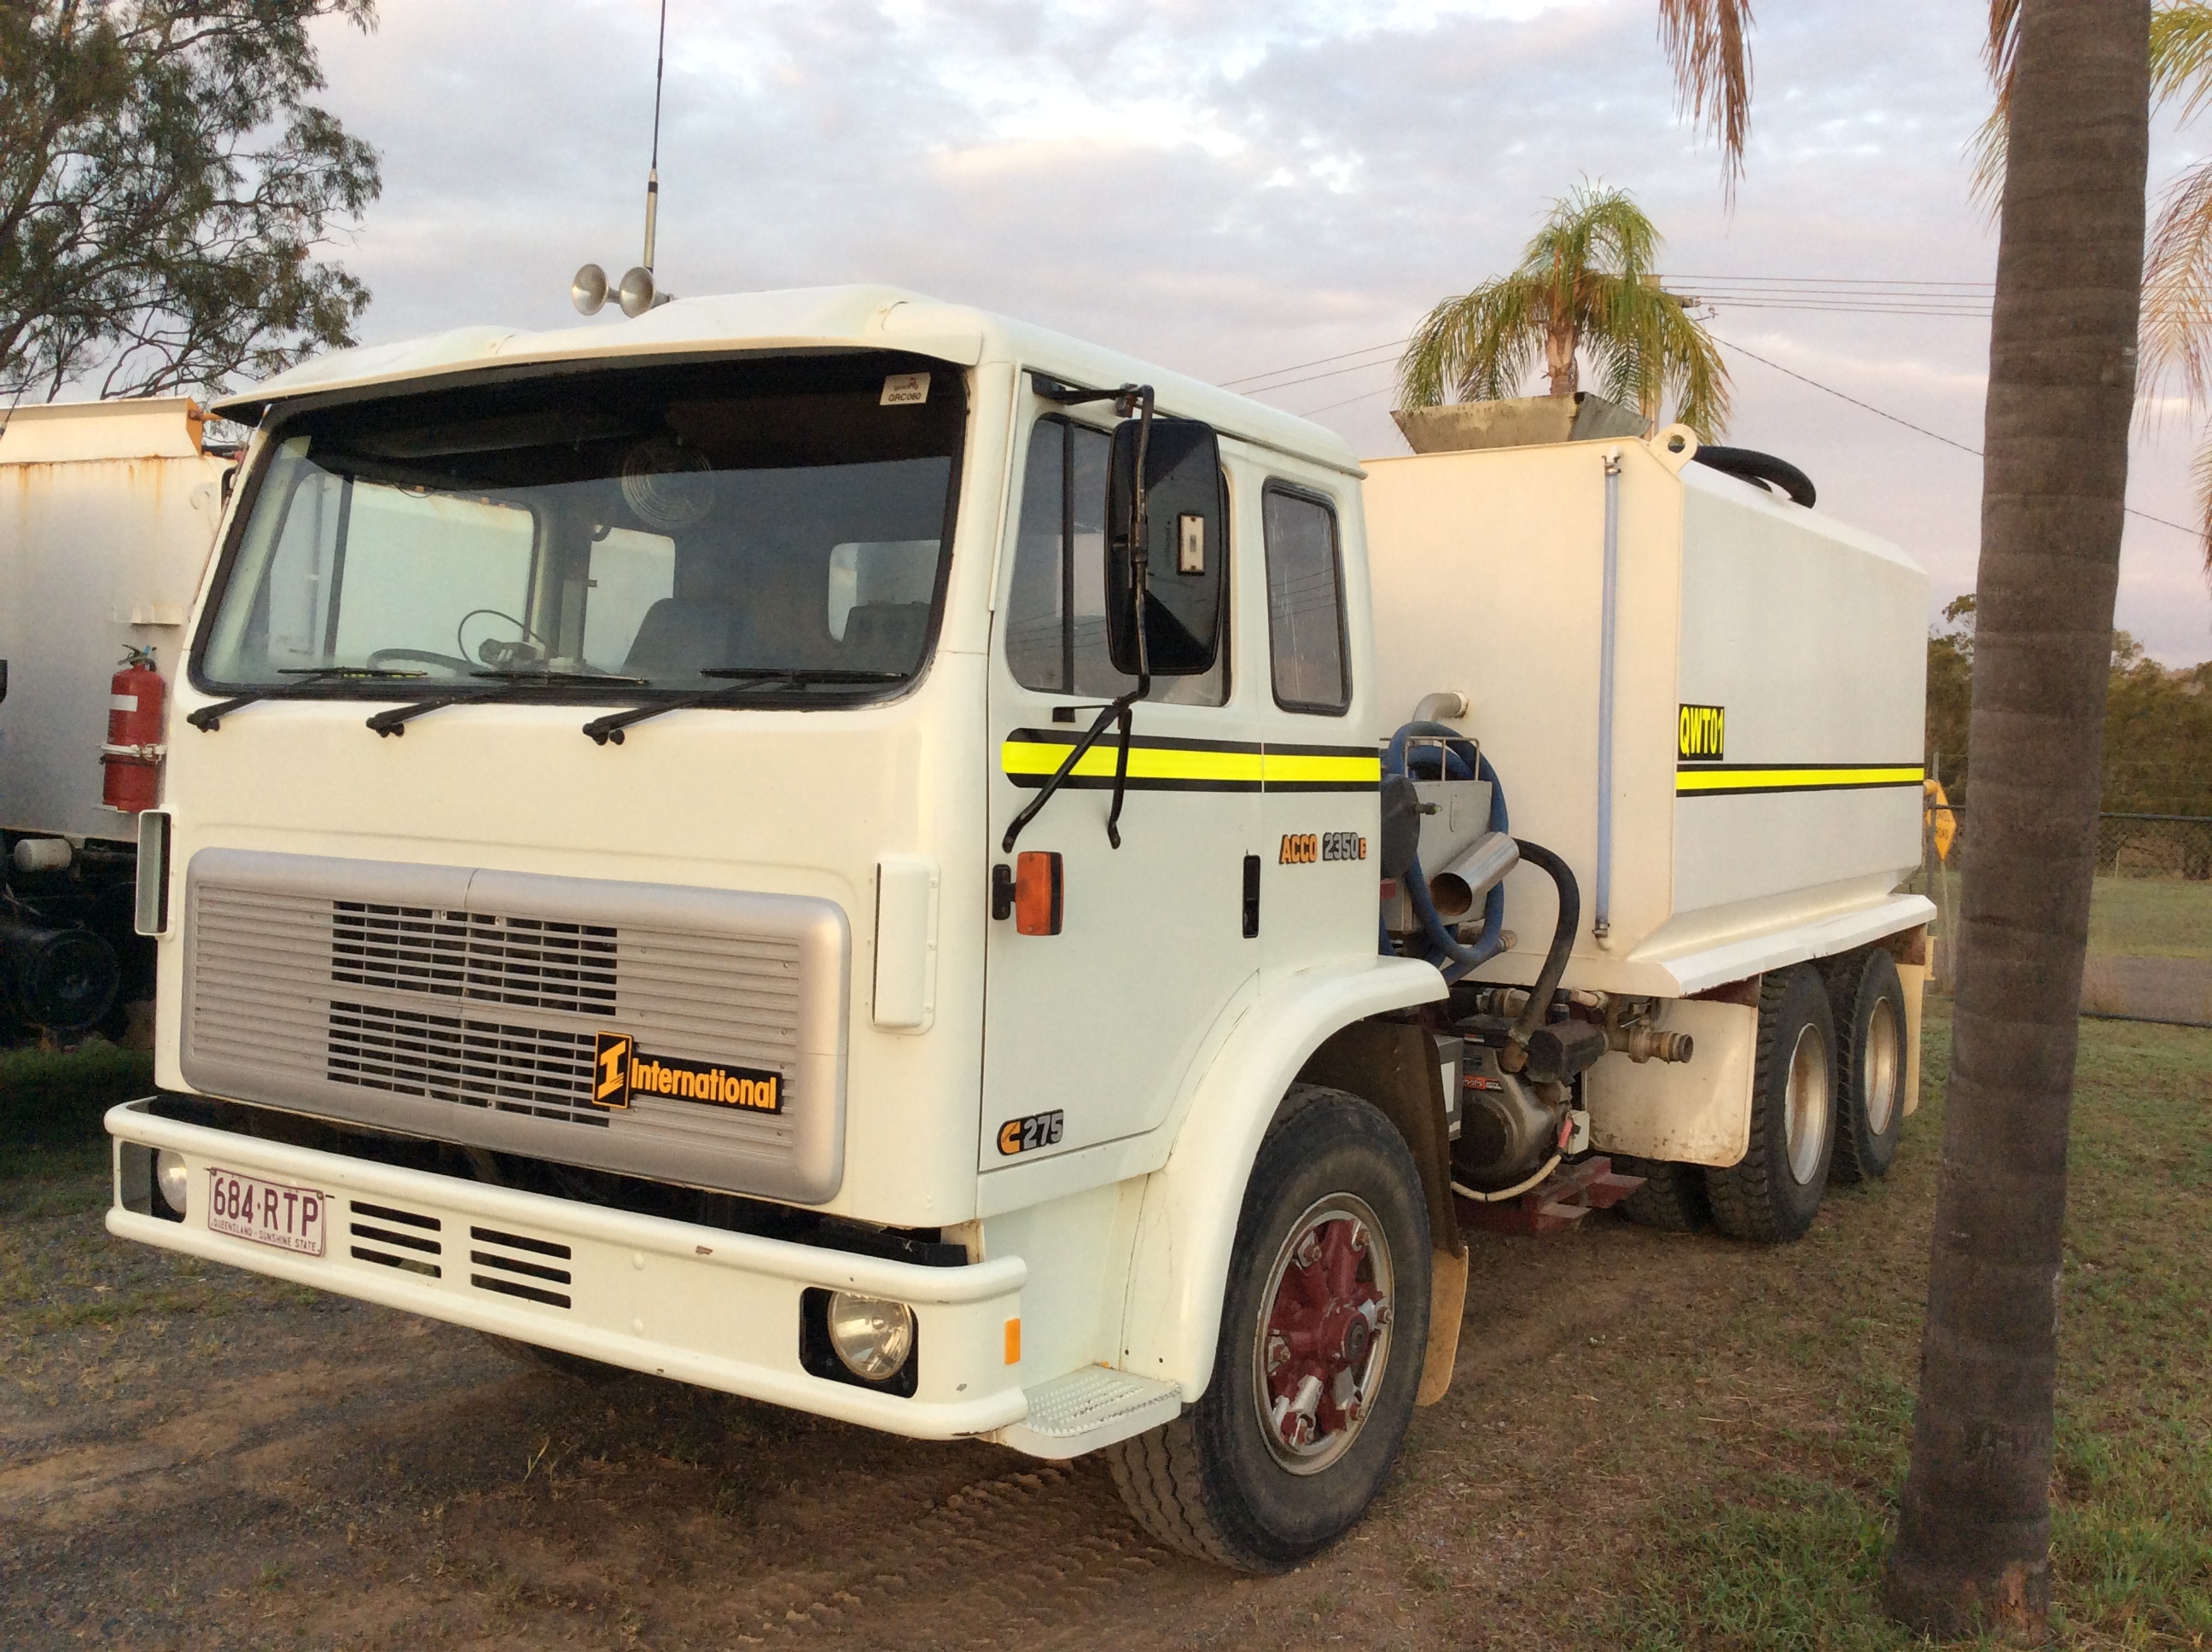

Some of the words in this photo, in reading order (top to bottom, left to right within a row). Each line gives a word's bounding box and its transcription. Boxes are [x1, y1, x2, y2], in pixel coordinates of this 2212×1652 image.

[1679, 707, 1724, 758] QWT01
[1279, 834, 1318, 864] ACCO
[631, 1057, 777, 1109] International
[1022, 1112, 1063, 1149] 275
[213, 1218, 253, 1236] QUEENSLAND
[259, 1230, 291, 1247] SUNSHINE
[294, 1238, 317, 1252] STATE
